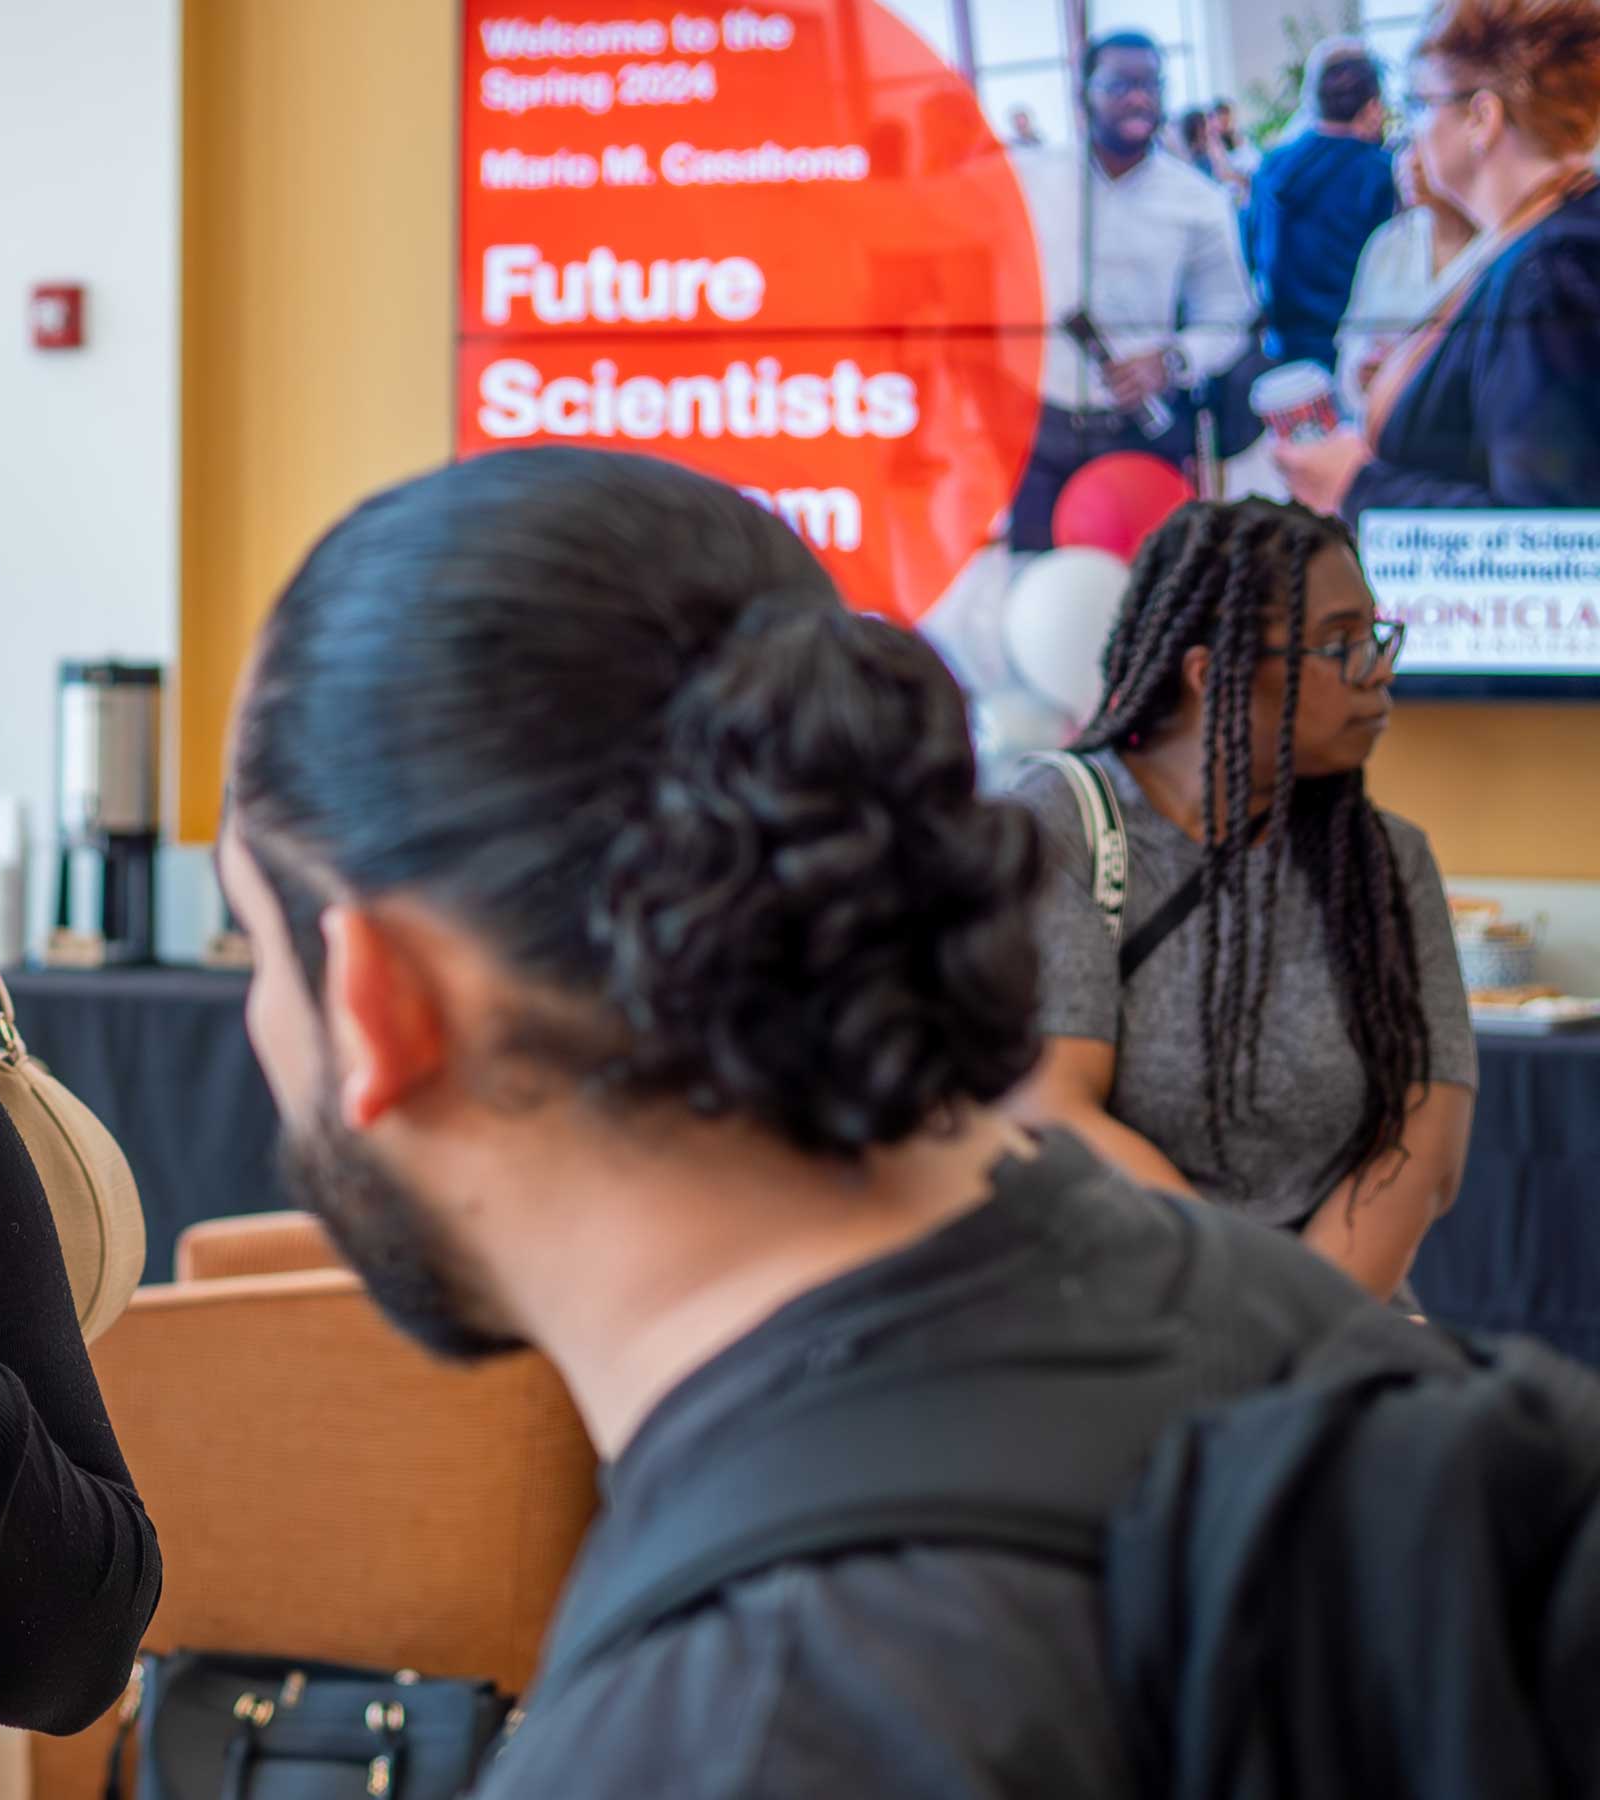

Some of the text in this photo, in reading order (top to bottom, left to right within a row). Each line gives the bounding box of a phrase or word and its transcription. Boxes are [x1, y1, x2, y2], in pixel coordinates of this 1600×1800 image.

[671, 13, 718, 53] to
[722, 9, 794, 51] the
[481, 67, 614, 115] Spring
[483, 244, 764, 324] Future
[478, 357, 918, 440] Scientists
